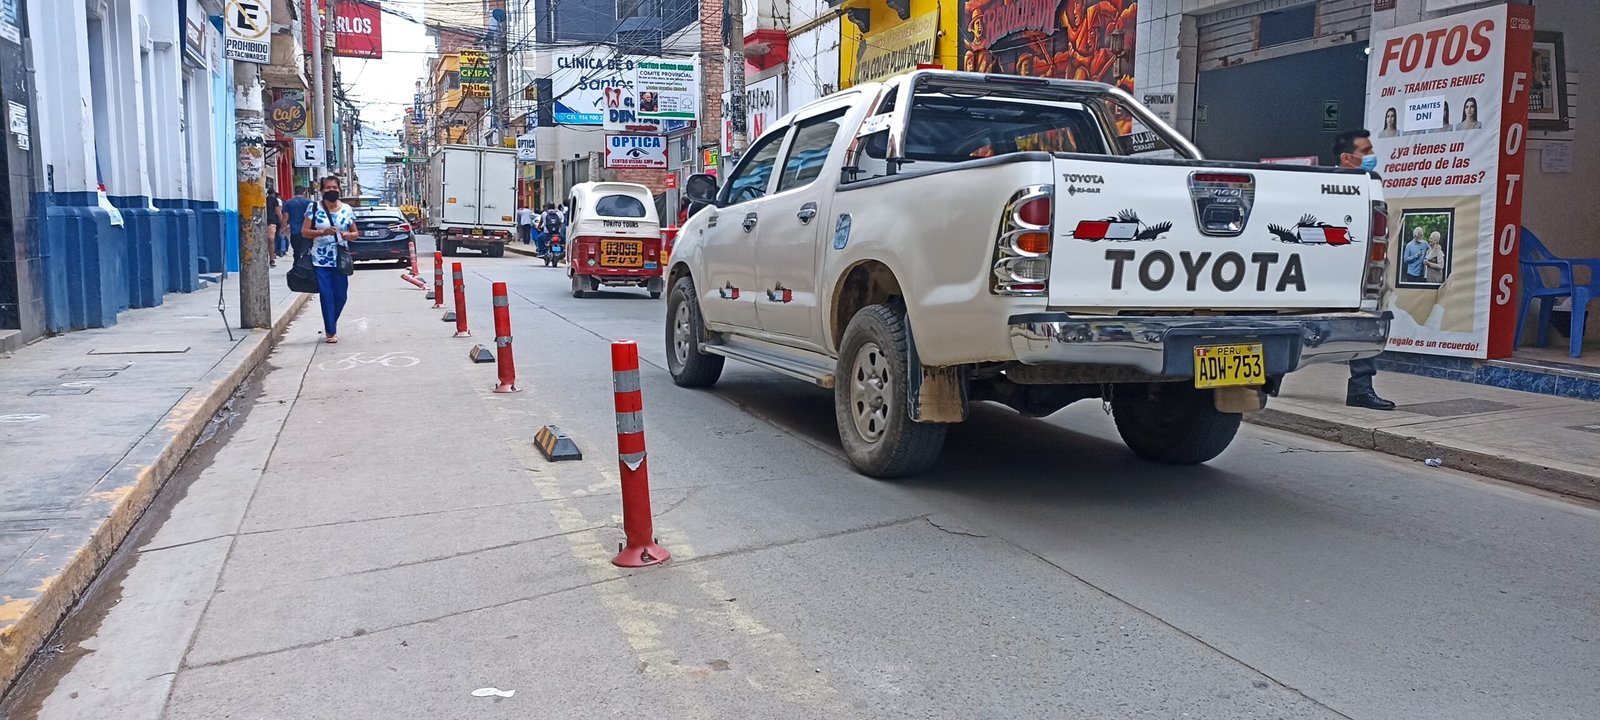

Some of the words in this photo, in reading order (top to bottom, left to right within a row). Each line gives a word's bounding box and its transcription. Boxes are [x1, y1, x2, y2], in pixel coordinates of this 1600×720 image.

[318, 16, 372, 34] CRLOS
[226, 39, 268, 54] PROHIBIDO
[1379, 19, 1495, 77] FOTOS
[557, 55, 604, 70] CLÍNICA
[608, 59, 620, 70] DE
[461, 69, 490, 78] CHIFA
[1381, 87, 1397, 98] DNI
[1405, 79, 1448, 95] TRAMITES
[1450, 73, 1486, 88] RENIEC
[1409, 102, 1441, 111] TRAMITES
[273, 106, 301, 123] Café
[1416, 112, 1432, 121] DNI
[612, 137, 661, 148] OPTICA
[1390, 147, 1410, 160] ¿ya
[1413, 143, 1447, 156] tienes
[1450, 142, 1465, 152] un
[1384, 159, 1431, 173] recuerdo
[1435, 157, 1449, 170] de
[1452, 157, 1470, 168] las
[1062, 174, 1104, 184] TOYOTA
[1382, 178, 1418, 188] rsonas
[1421, 175, 1443, 188] que
[1445, 171, 1486, 185] amas?
[1321, 184, 1361, 196] HILUX
[622, 220, 639, 228] TOURS
[1104, 248, 1307, 293] TOYOTA
[1217, 347, 1241, 356] PERU
[1388, 338, 1414, 347] regalo
[1426, 340, 1437, 348] un
[1438, 340, 1480, 352] recuerdo!
[1199, 355, 1262, 381] ADW-753
